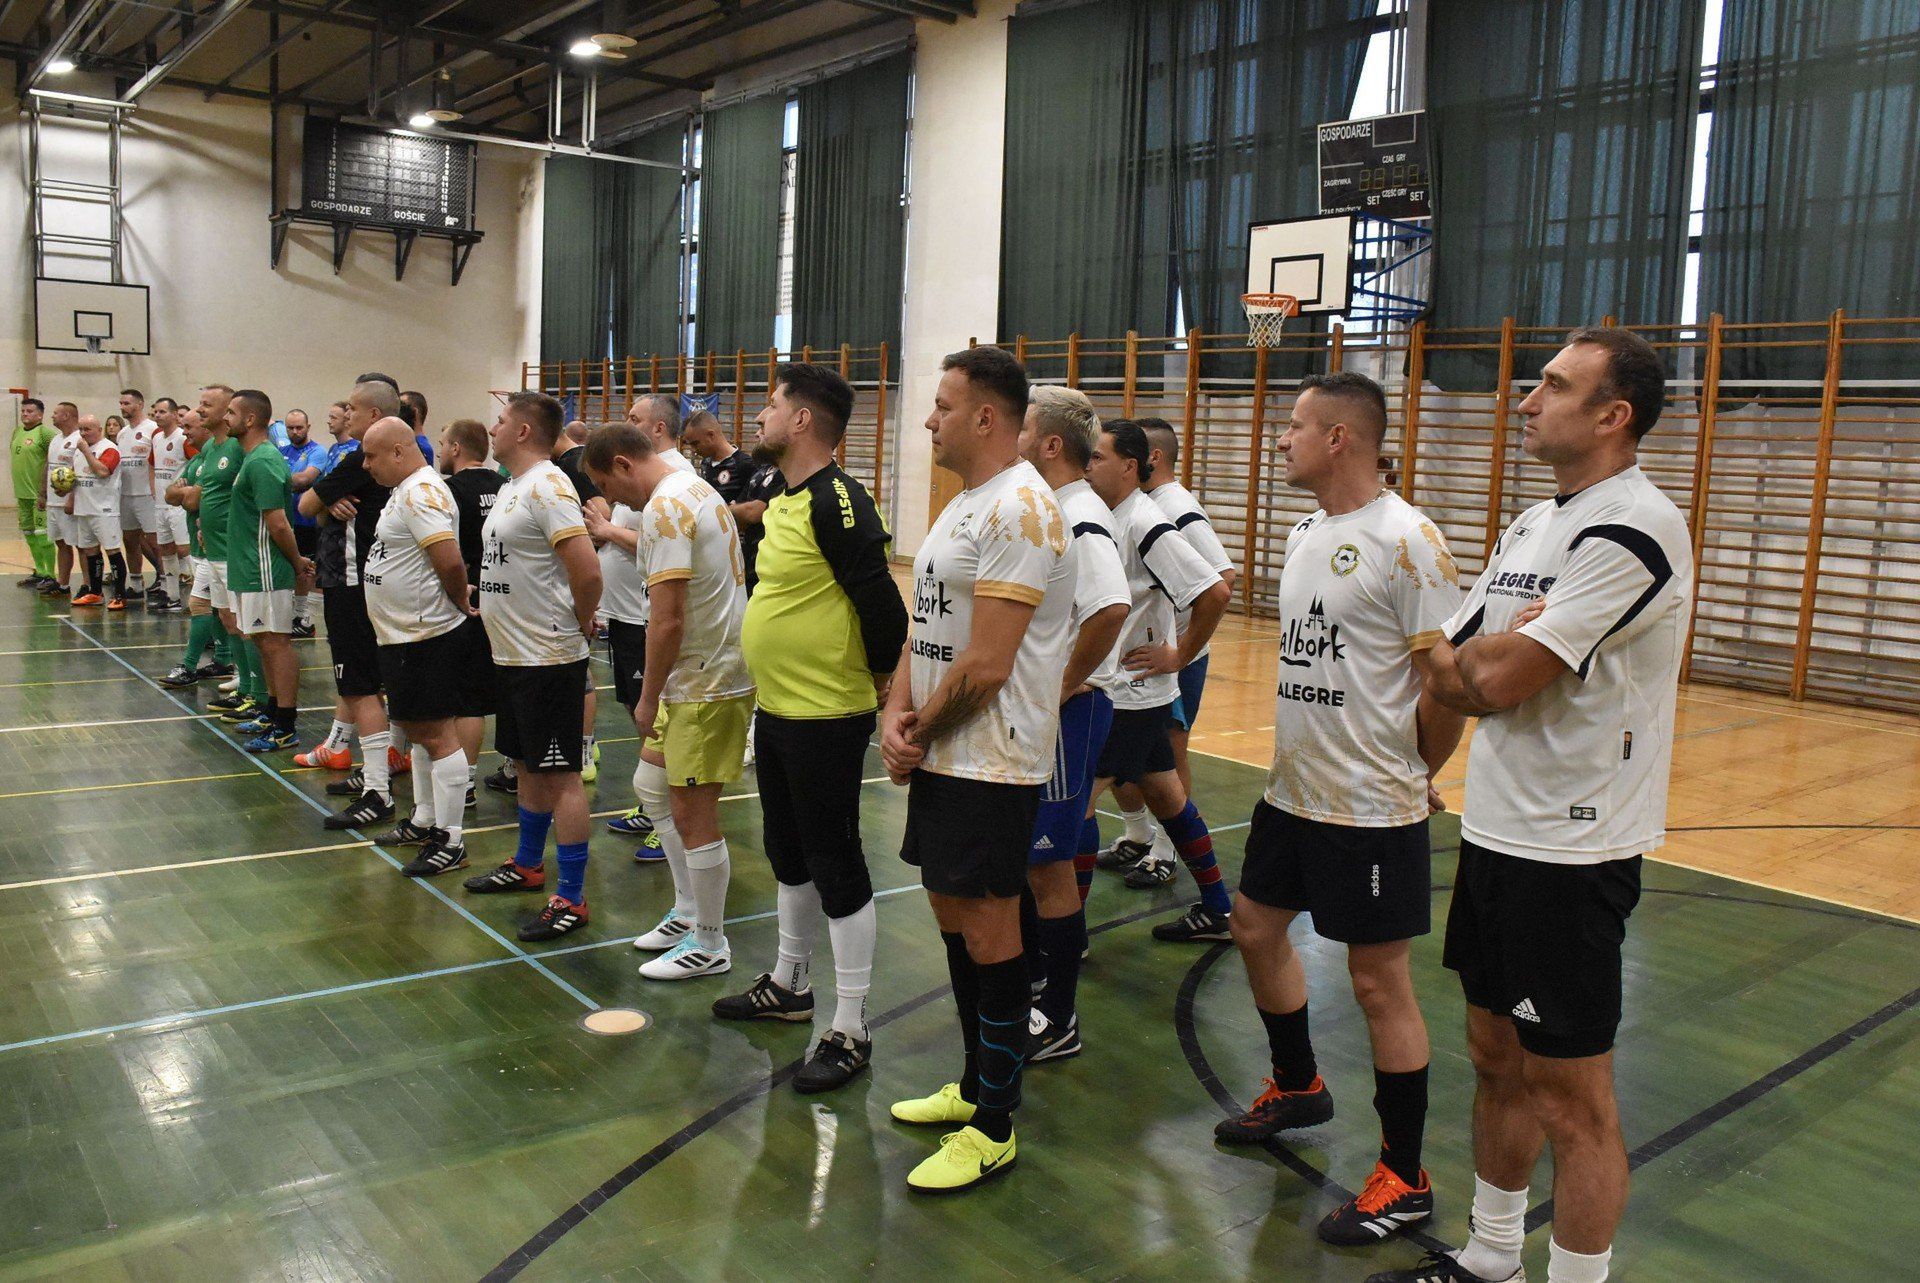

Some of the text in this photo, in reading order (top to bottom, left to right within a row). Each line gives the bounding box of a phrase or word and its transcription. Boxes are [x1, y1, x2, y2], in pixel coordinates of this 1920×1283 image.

[1320, 123, 1371, 142] GOSPODARZE
[1366, 195, 1381, 206] SET
[1409, 191, 1424, 202] SET
[311, 200, 372, 216] GOSPODARZE
[394, 210, 426, 222] GOŚCIE
[334, 663, 344, 679] 17
[1277, 682, 1346, 708] ALEGRE
[1370, 864, 1380, 897] adidas
[1512, 1008, 1541, 1023] adidas
